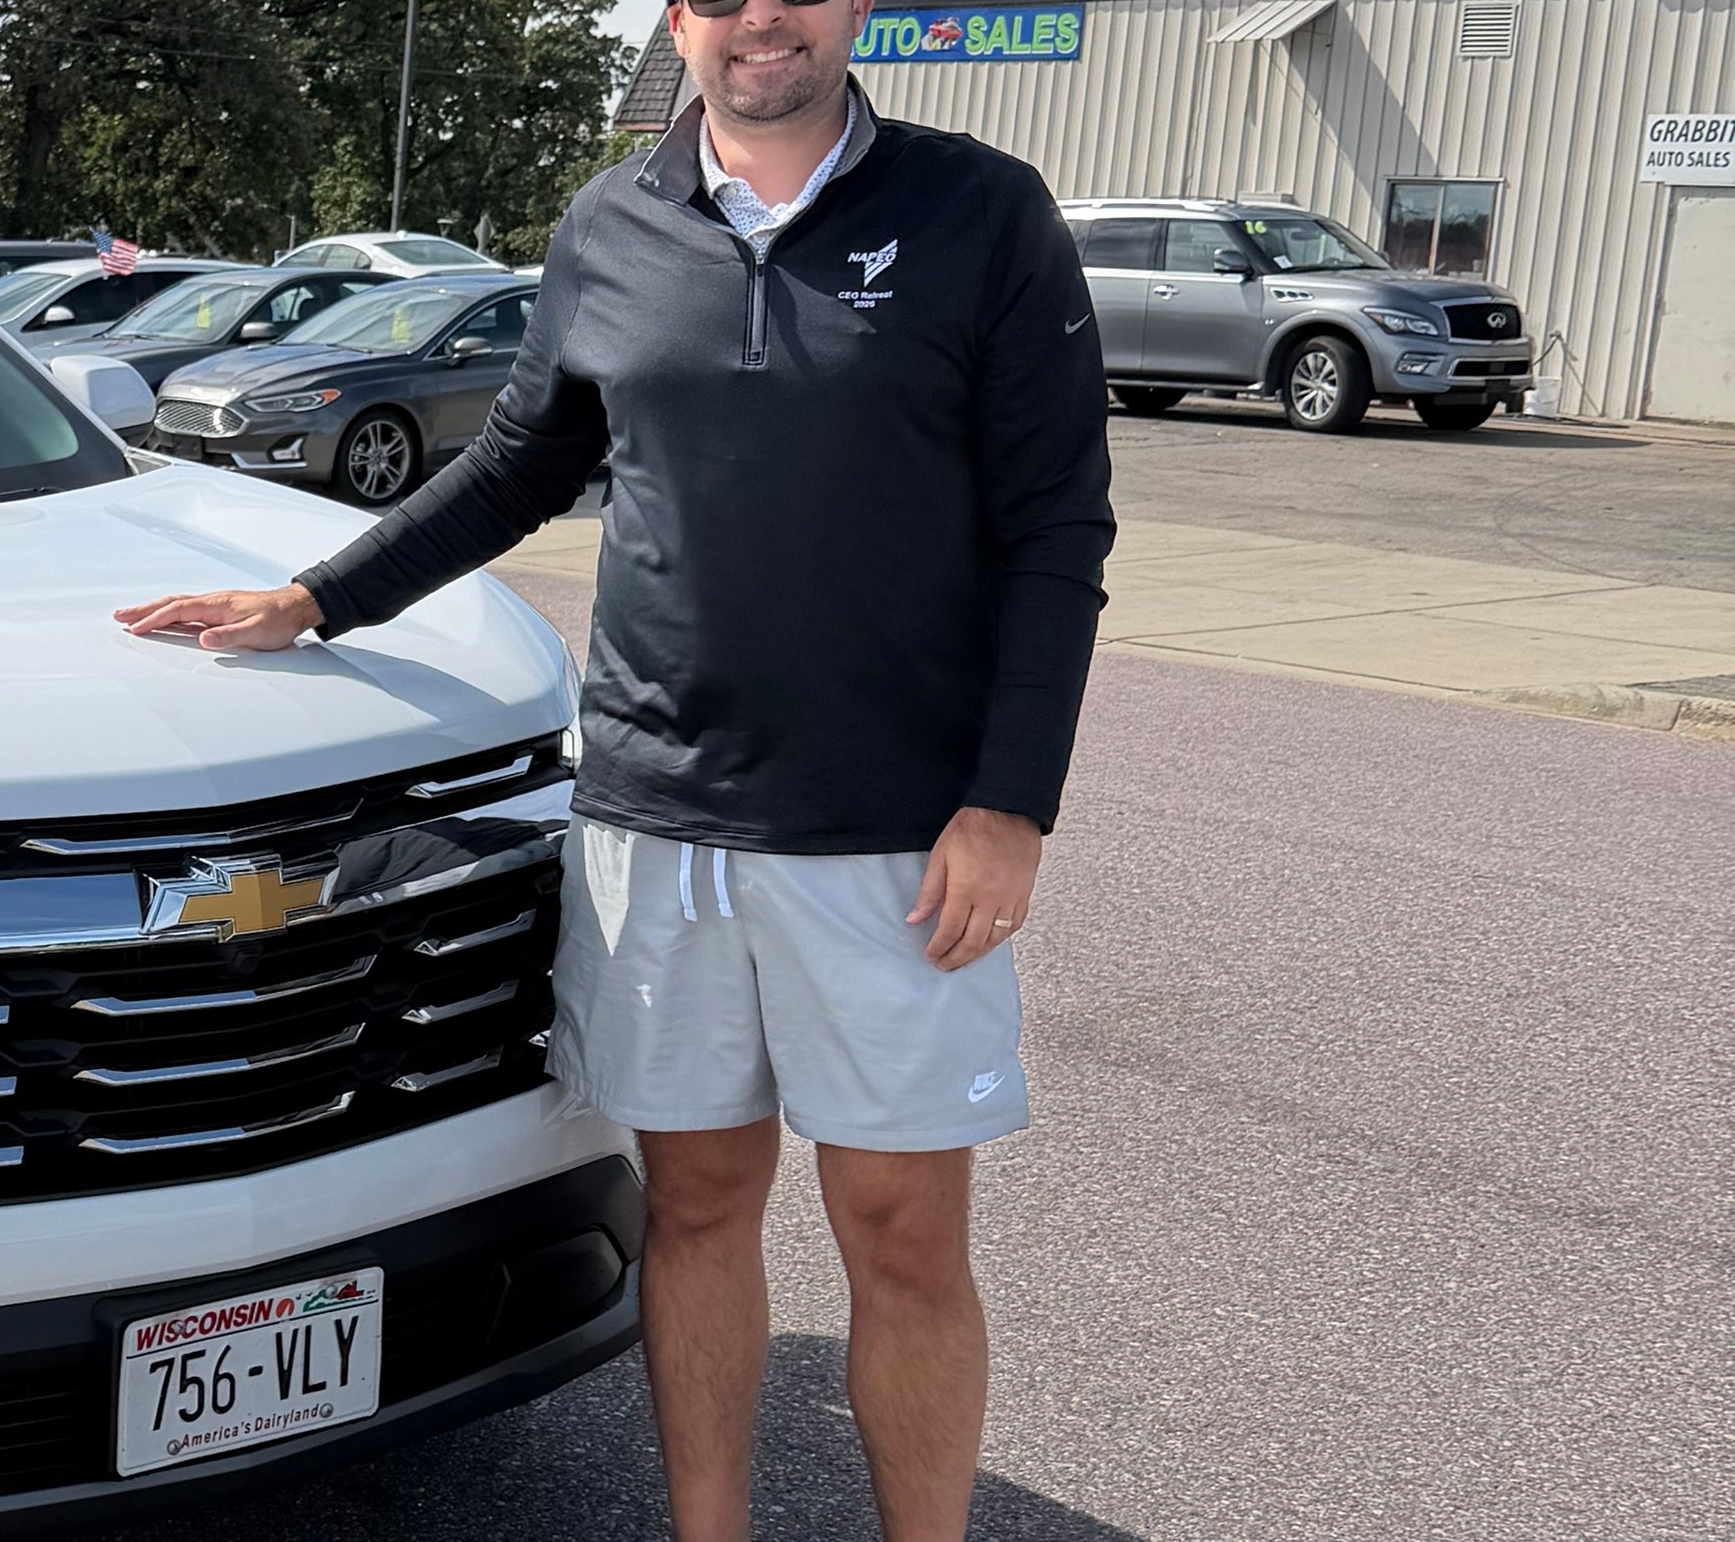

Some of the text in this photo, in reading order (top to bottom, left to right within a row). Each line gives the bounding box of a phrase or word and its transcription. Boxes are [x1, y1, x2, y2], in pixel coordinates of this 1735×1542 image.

[850, 12, 1078, 56] UTO SALES
[1647, 151, 1730, 167] AUTO SALES
[1245, 220, 1267, 234] 16
[837, 291, 859, 300] CEO
[136, 1298, 273, 1351] WISCONSIN
[149, 1315, 359, 1431] 756-VLY
[180, 1404, 319, 1449] America's Dairyland
